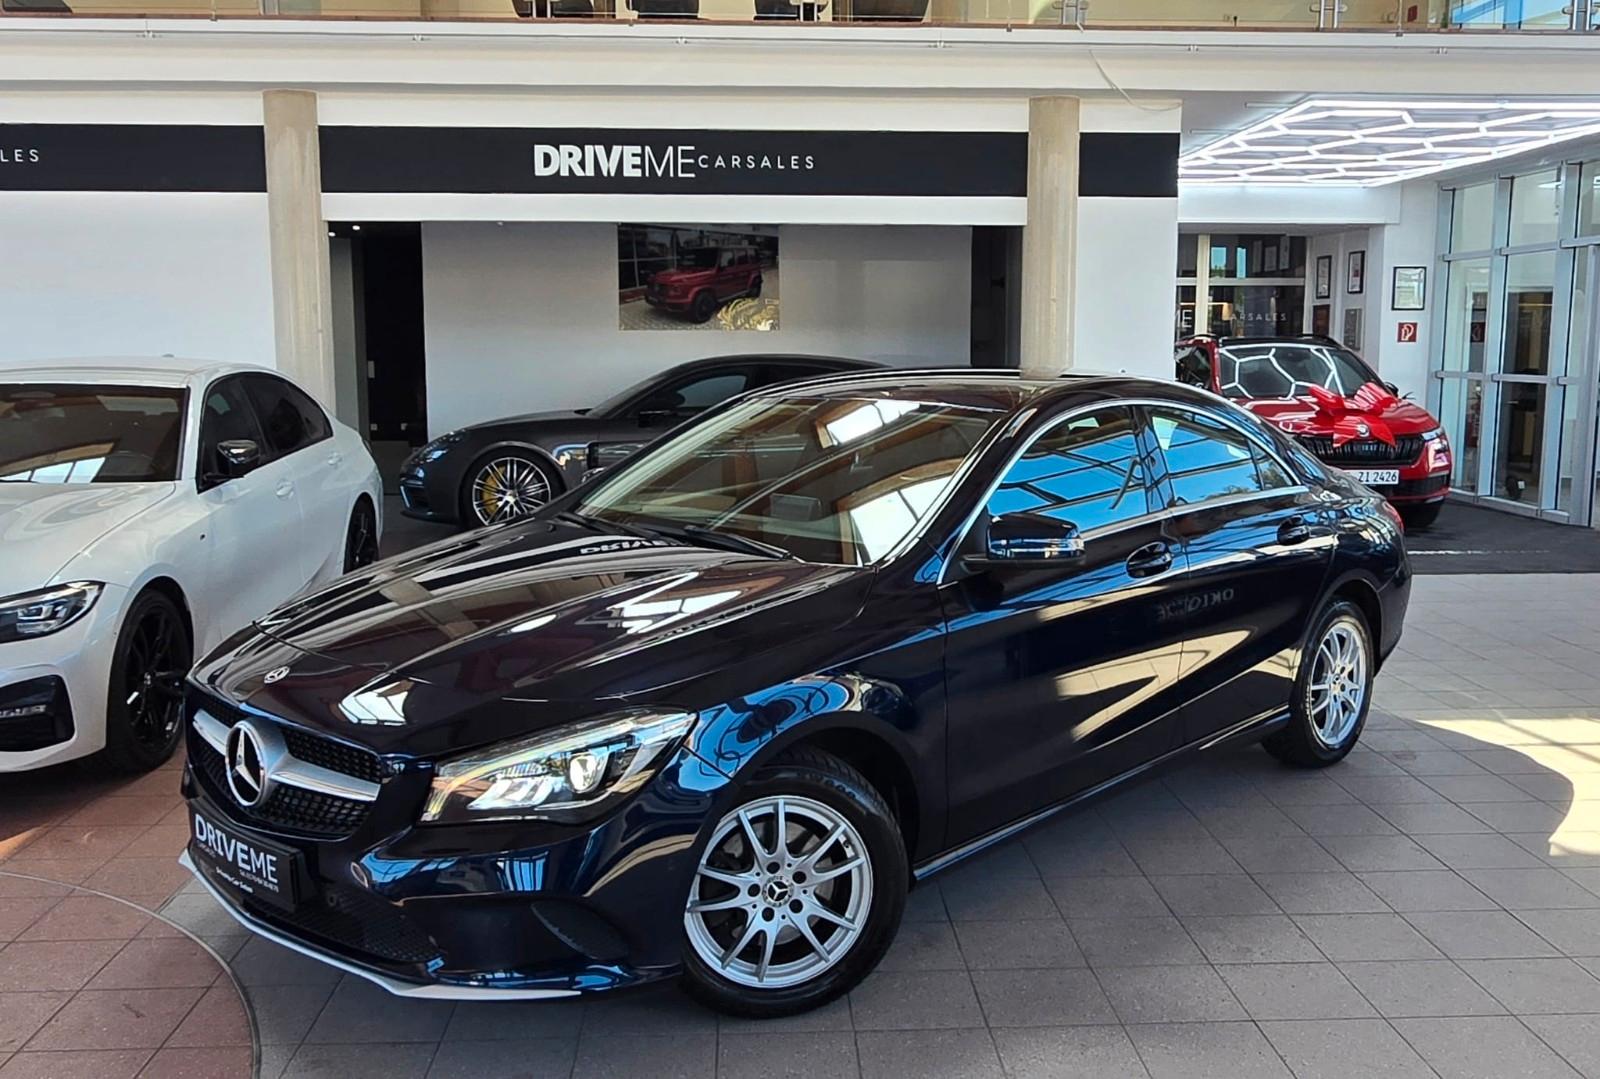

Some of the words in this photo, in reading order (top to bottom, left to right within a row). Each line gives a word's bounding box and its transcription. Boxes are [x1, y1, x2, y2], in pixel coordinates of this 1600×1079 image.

[533, 143, 696, 178] DRIVEME
[698, 154, 815, 170] CARSALES
[1373, 471, 1398, 483] 2426
[195, 813, 278, 883] DRIVEME
